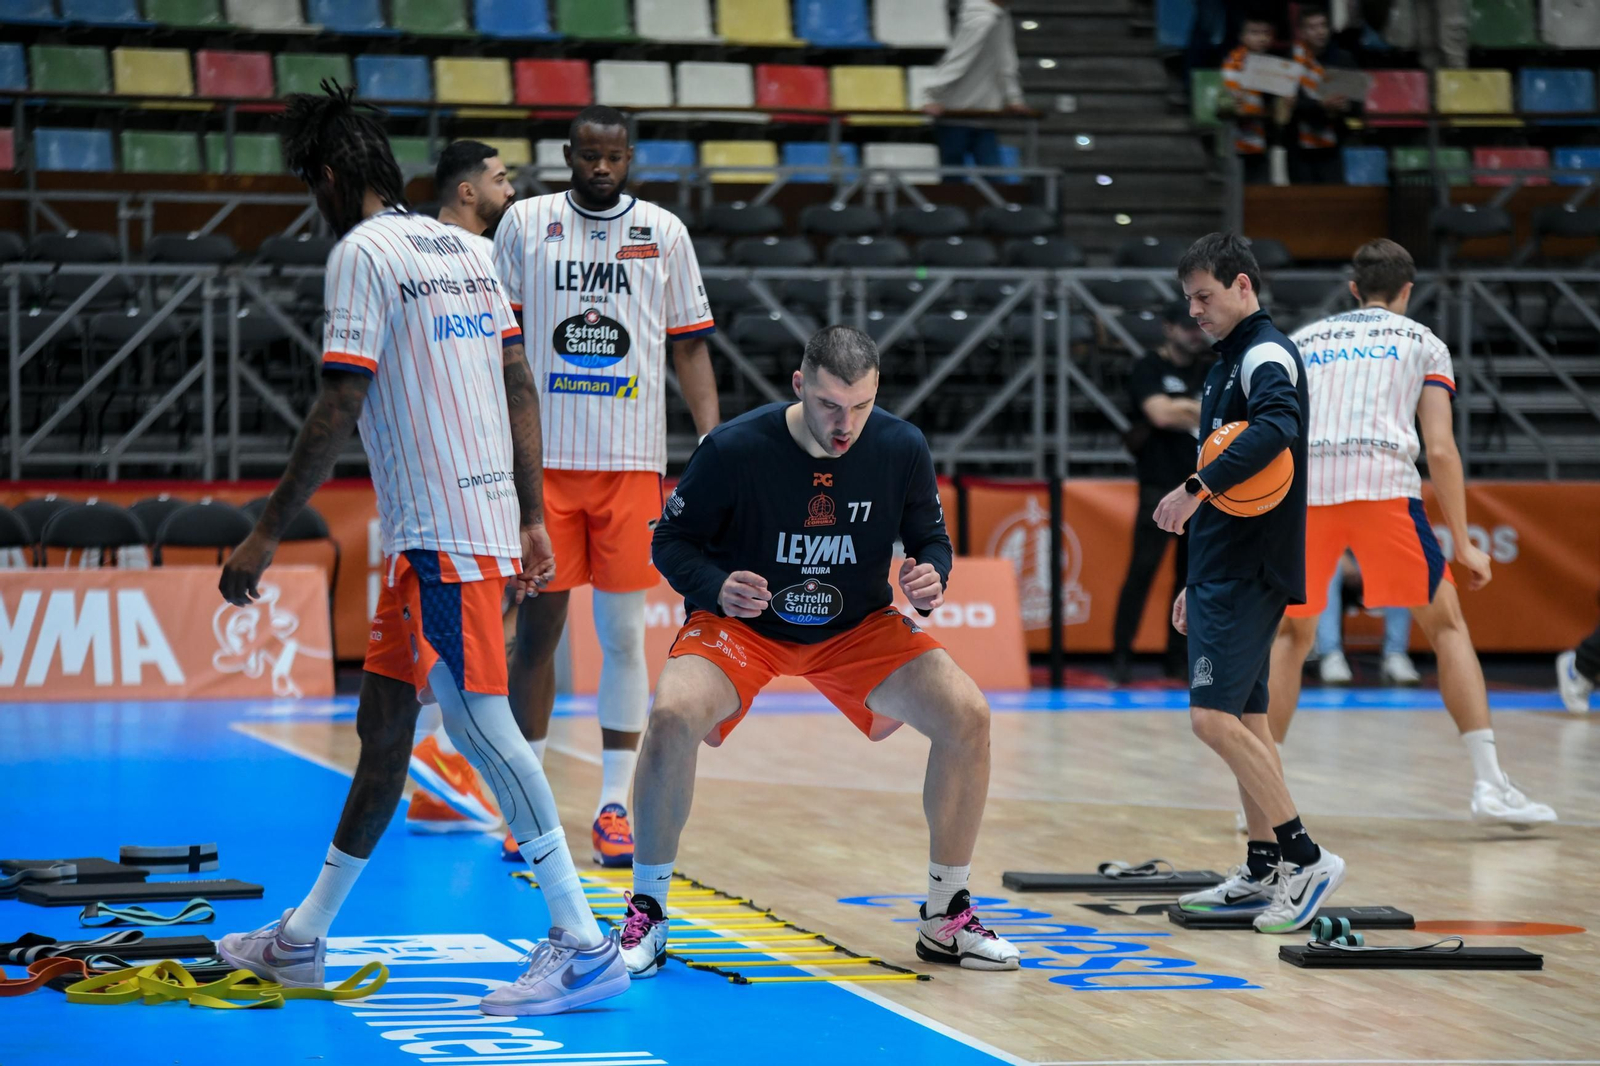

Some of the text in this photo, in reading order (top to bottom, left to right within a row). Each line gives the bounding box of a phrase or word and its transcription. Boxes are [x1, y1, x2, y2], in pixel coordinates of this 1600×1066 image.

[555, 260, 632, 295] LEYMA
[564, 323, 619, 341] Estrella
[565, 338, 616, 355] Galicia
[1309, 345, 1400, 366] ABANCA
[553, 377, 610, 393] Aluman
[848, 501, 872, 523] 77
[775, 531, 858, 565] LEYMA
[801, 566, 831, 575] NATURA
[784, 591, 832, 604] Estrella
[784, 601, 829, 615] Galicia
